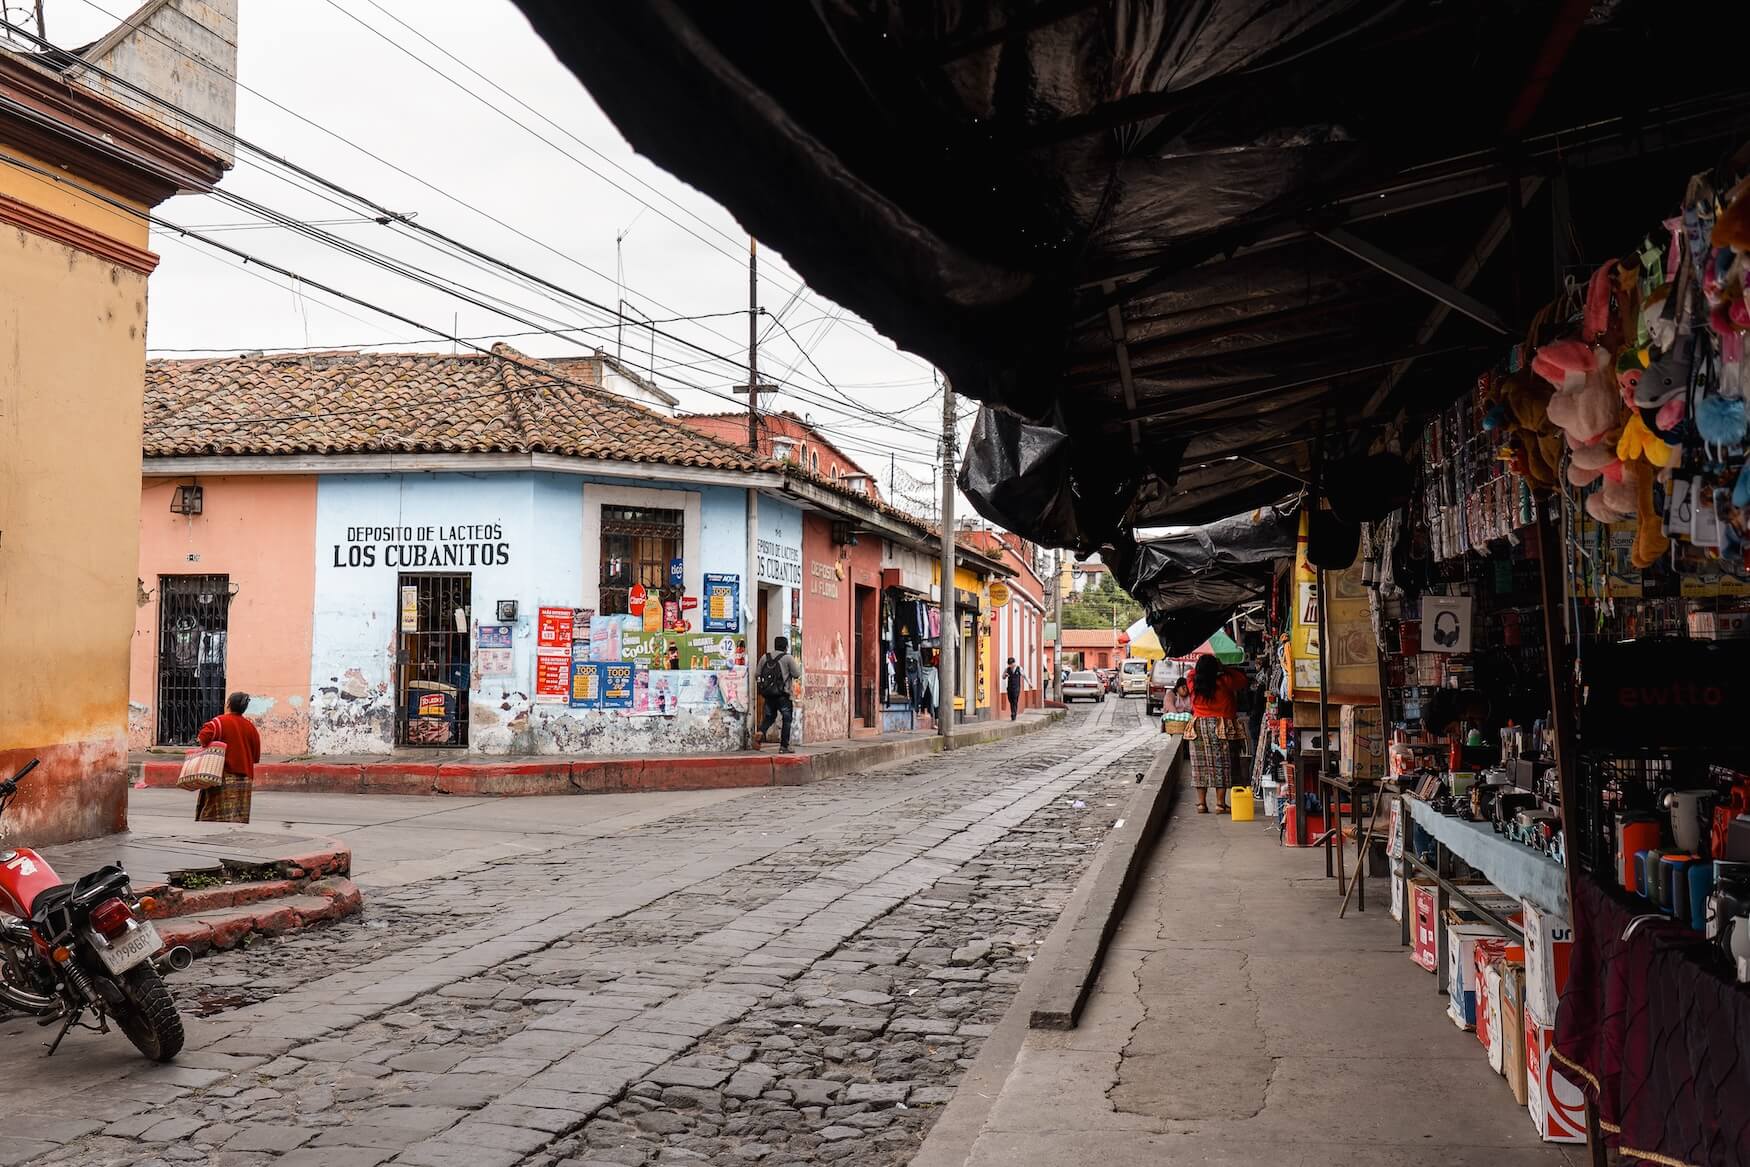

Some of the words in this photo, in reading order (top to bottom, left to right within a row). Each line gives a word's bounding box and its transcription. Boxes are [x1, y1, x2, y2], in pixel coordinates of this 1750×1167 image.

[347, 526, 412, 542] DEPOSITO
[417, 526, 435, 541] DE
[440, 524, 503, 541] LACTEOS
[333, 544, 376, 569] LOS
[384, 543, 510, 568] CUBANITOS
[757, 539, 775, 556] EPOSITO
[767, 558, 801, 585] CUBANITOS
[576, 666, 597, 675] TODO
